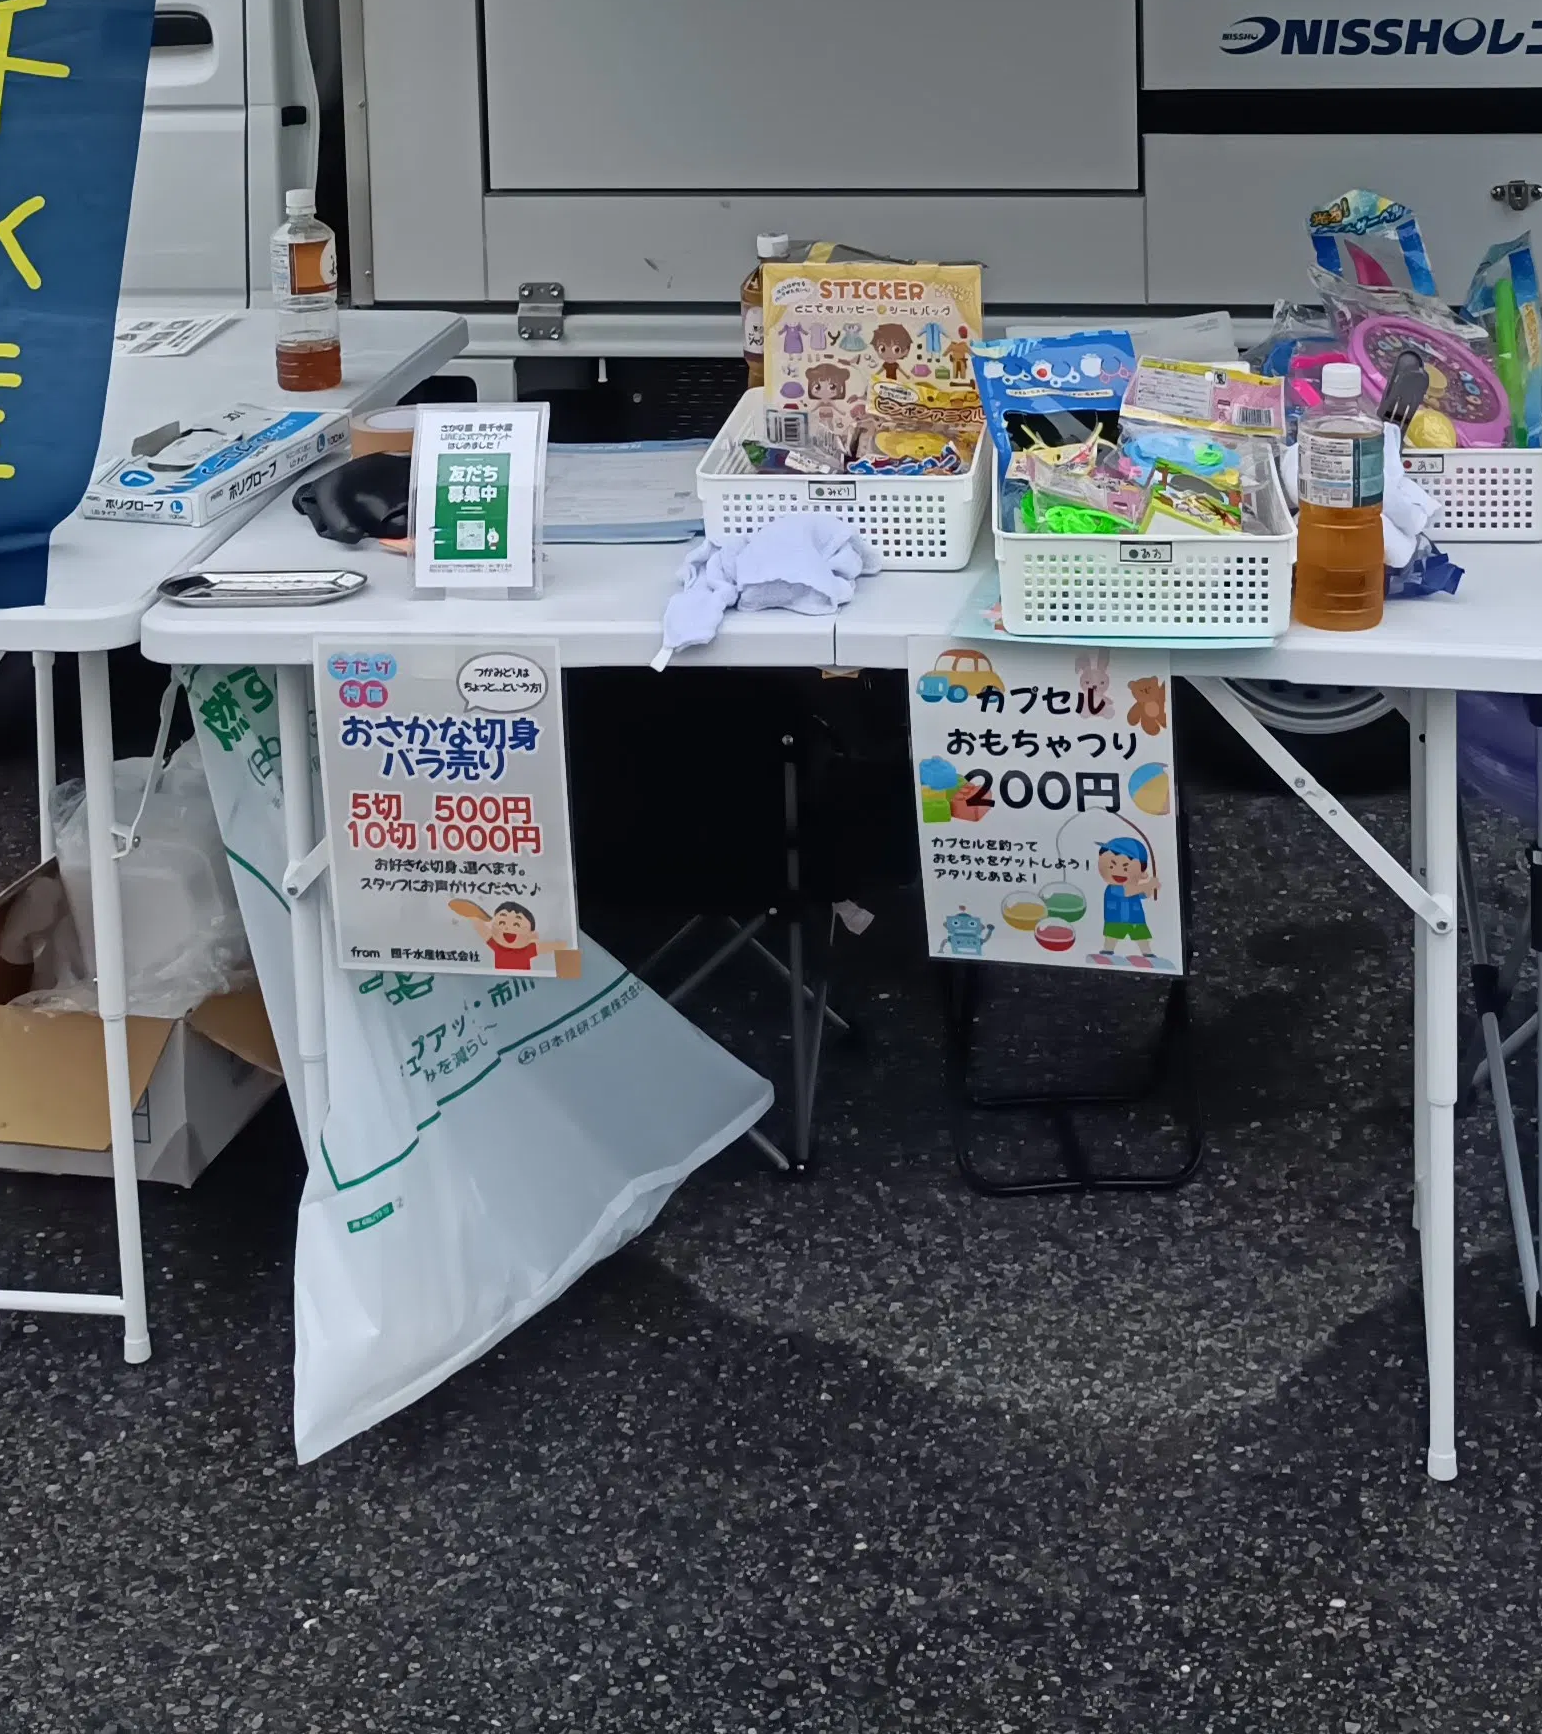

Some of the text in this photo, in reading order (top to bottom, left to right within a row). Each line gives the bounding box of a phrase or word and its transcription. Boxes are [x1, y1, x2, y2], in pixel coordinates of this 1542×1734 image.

[819, 279, 925, 301] STICKER
[448, 465, 499, 482] 友だち
[333, 660, 393, 674] 今だけ
[976, 686, 1106, 715] カプセル
[341, 715, 540, 752] おさかな切身
[946, 728, 1137, 760] おもちゃつり
[382, 748, 506, 781] バラ売り
[964, 768, 1121, 814] 200円
[351, 793, 532, 824] 5切 500円
[347, 822, 541, 854] 10切 1000円
[931, 837, 1038, 852] カプセルを釣って
[351, 946, 380, 959] from
